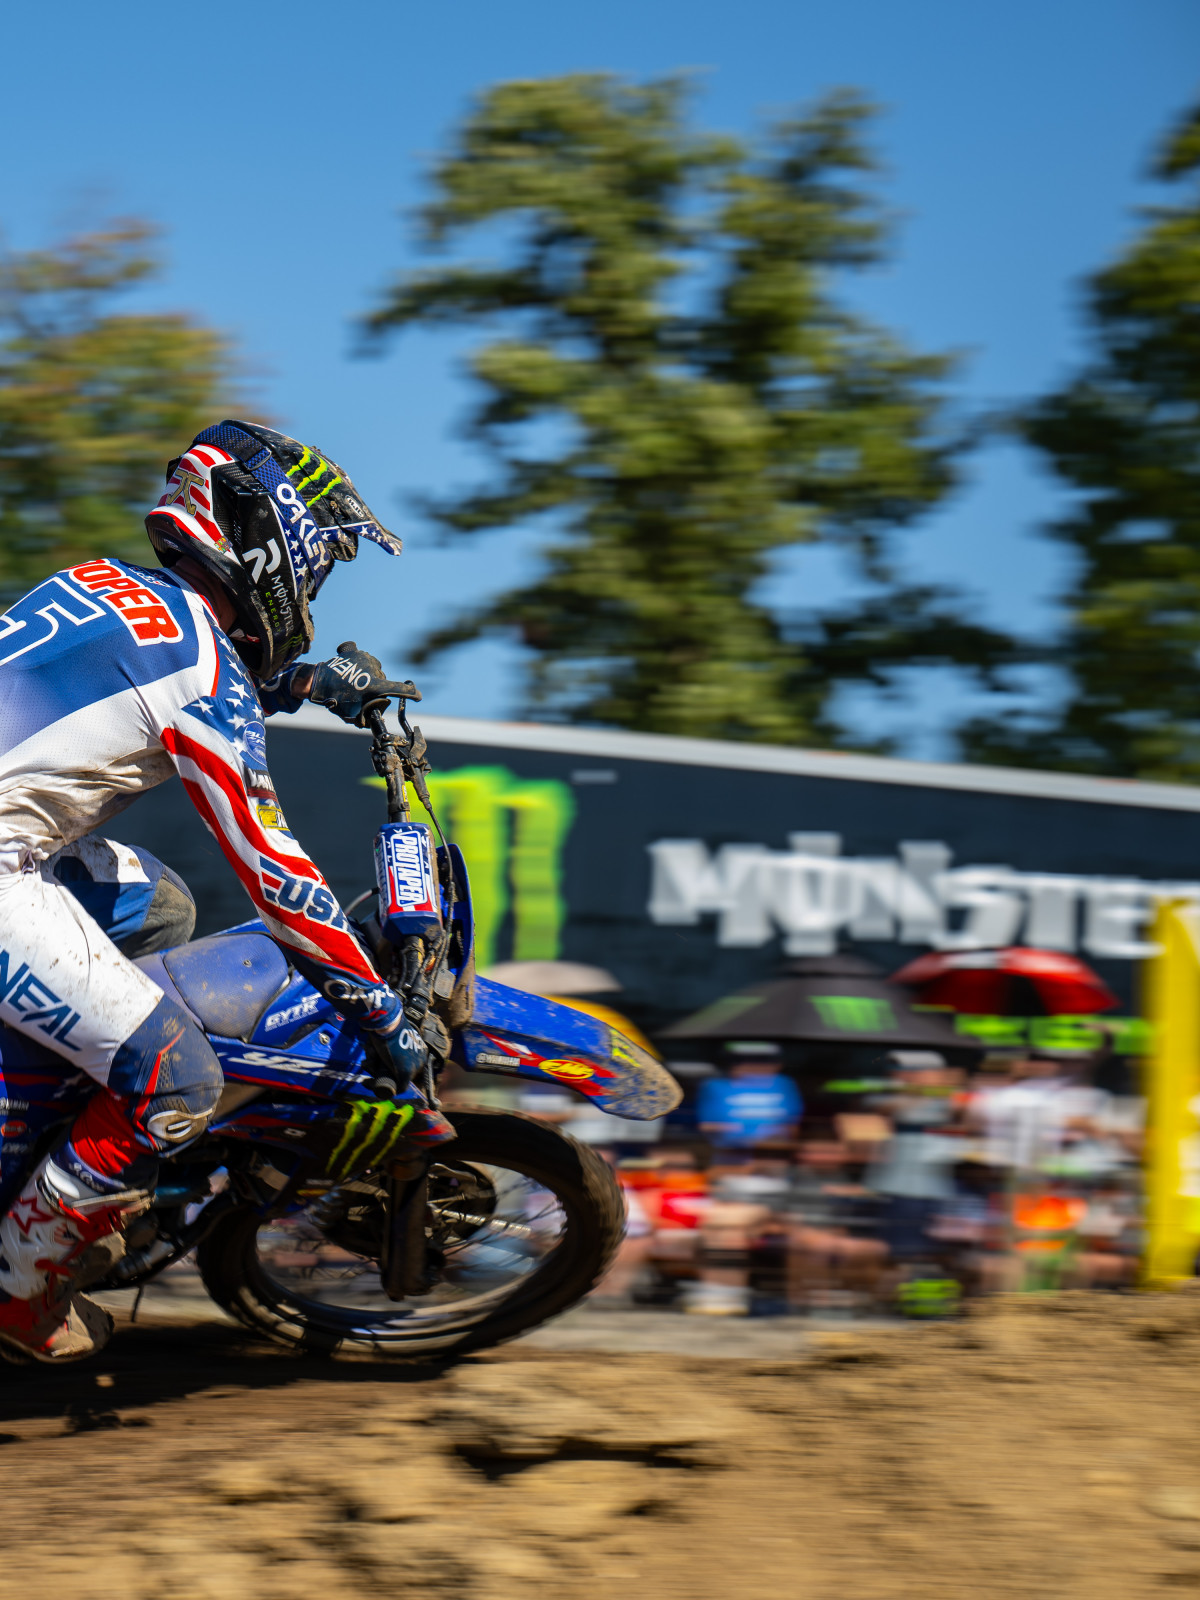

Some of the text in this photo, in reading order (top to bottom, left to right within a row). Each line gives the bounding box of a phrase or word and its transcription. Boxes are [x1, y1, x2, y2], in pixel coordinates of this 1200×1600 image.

[276, 483, 330, 571] OAKLEY
[58, 557, 184, 647] OPER
[394, 834, 425, 904] PROTAPER
